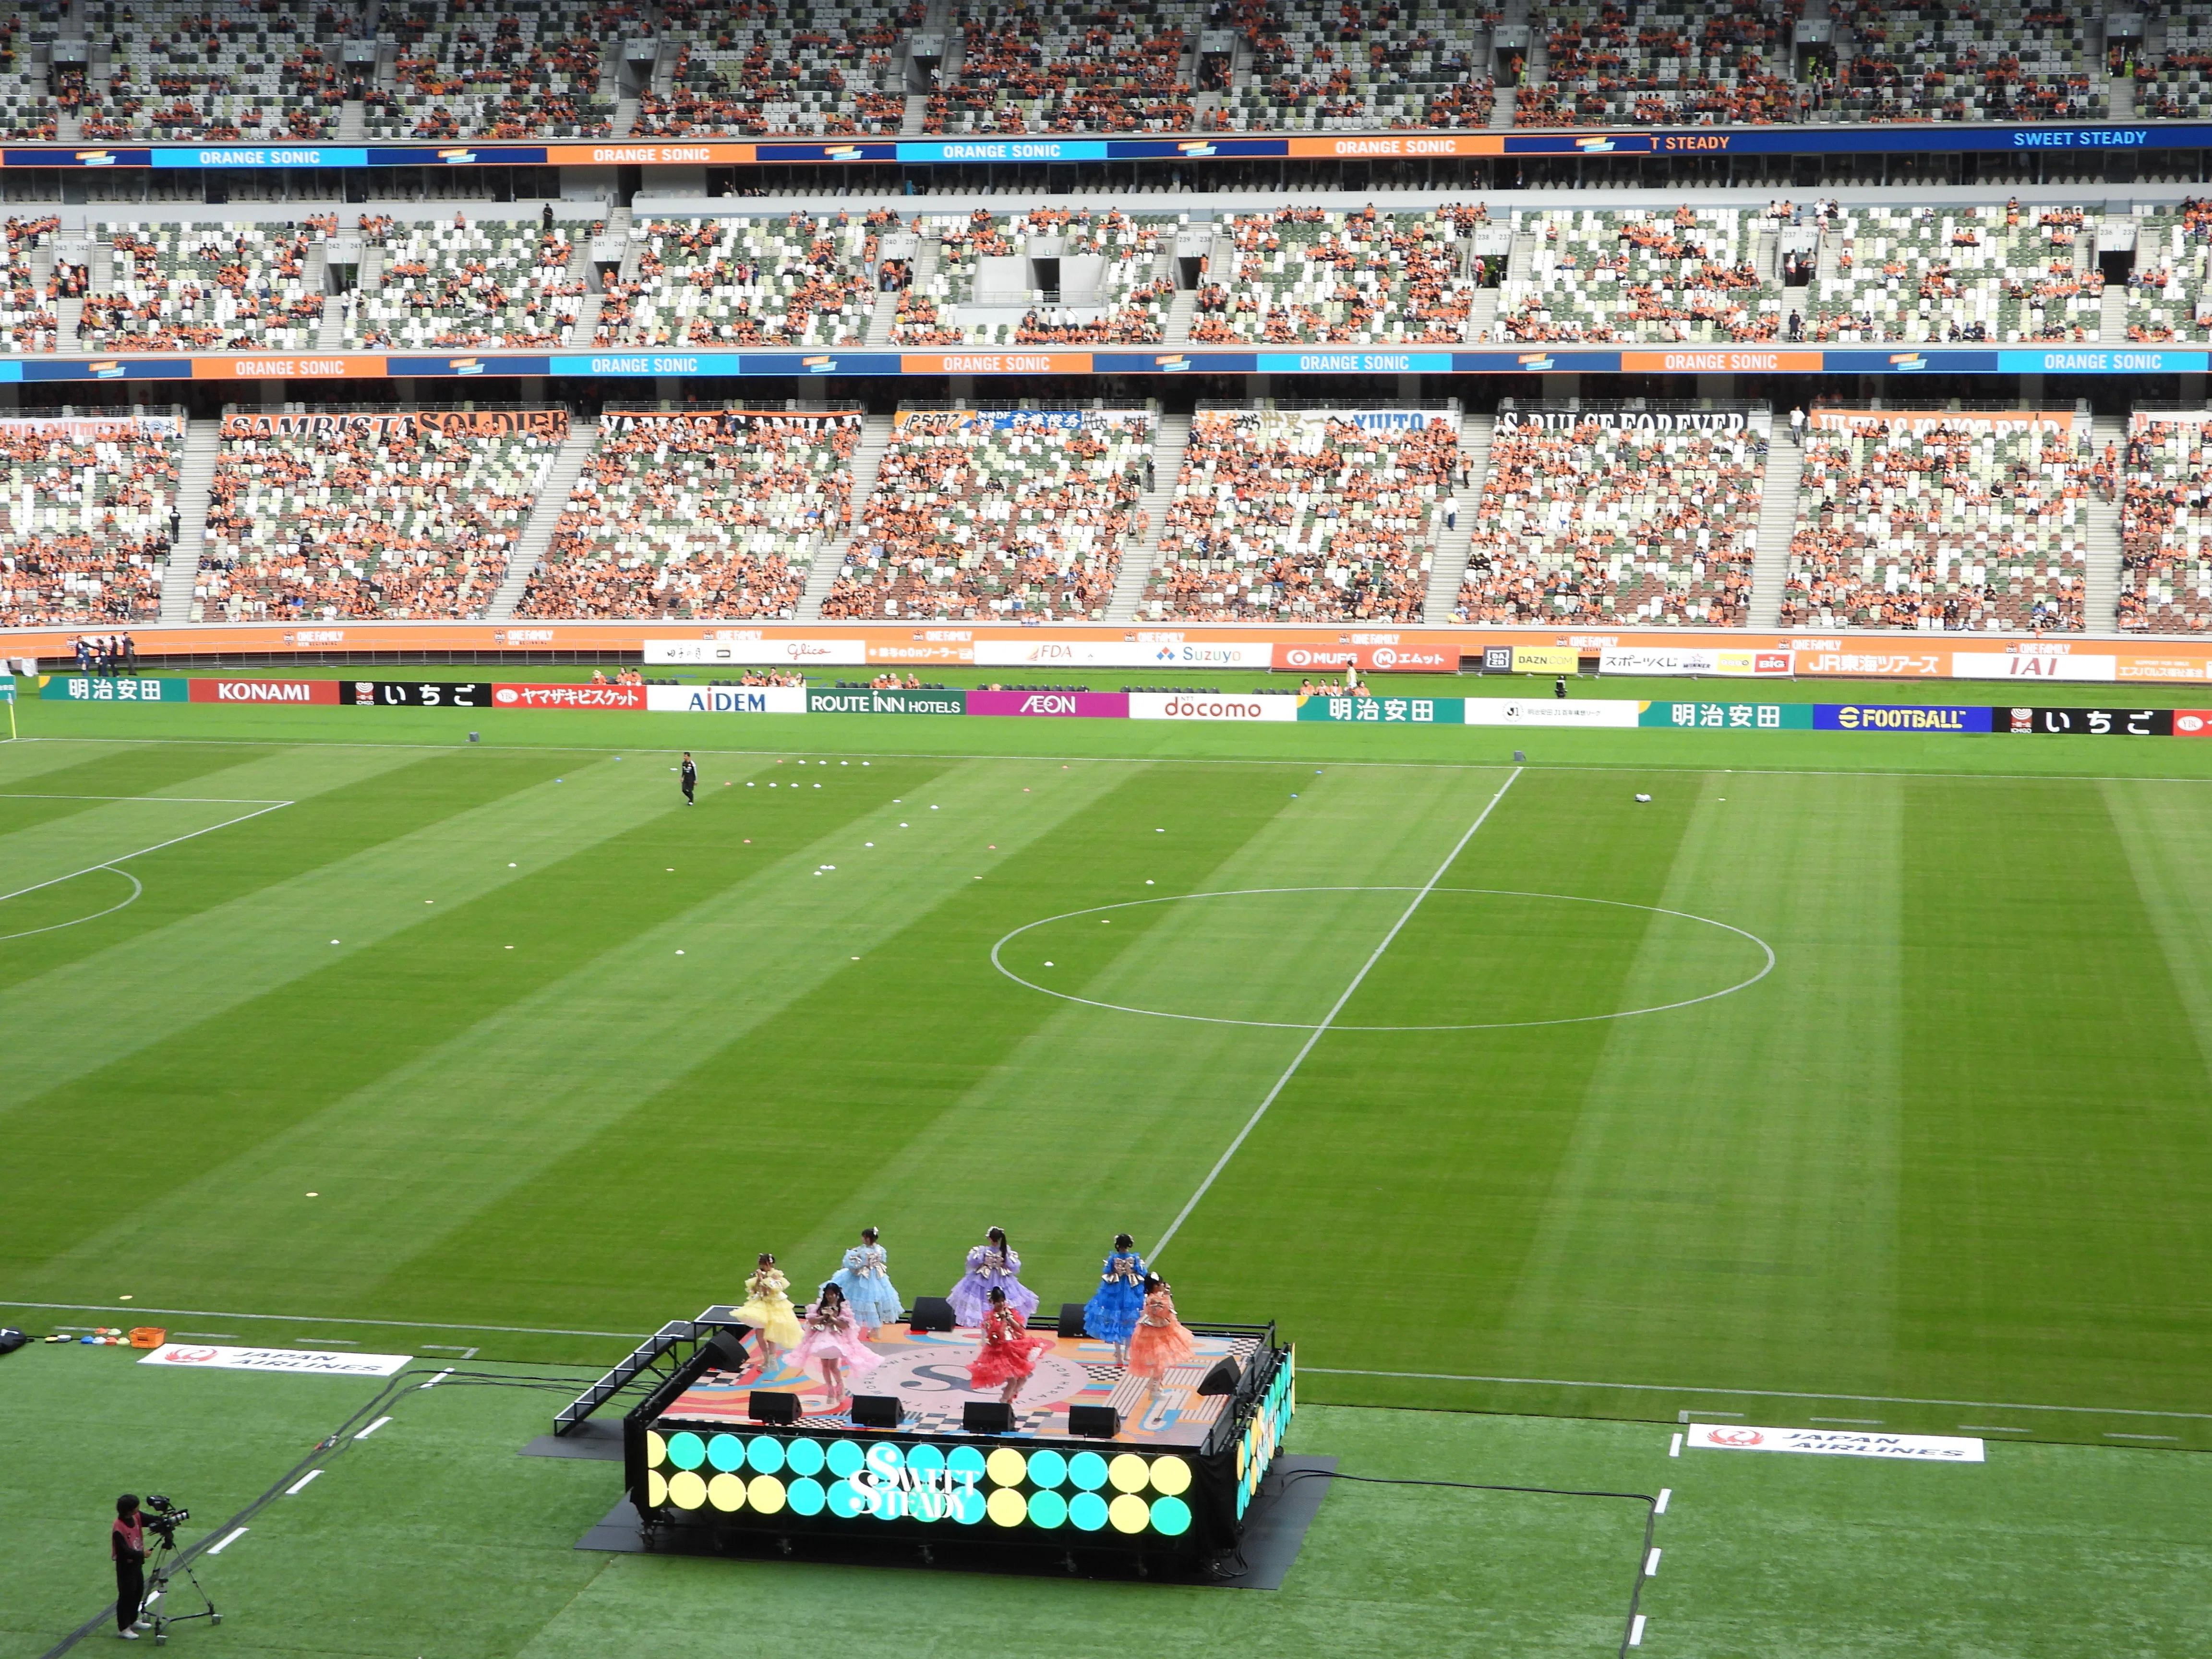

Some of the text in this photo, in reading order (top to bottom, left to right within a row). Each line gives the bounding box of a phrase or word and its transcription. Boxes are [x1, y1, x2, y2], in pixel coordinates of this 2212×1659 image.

[1665, 135, 1730, 149] STEADY
[2013, 131, 2147, 146] SWEET STEADY
[943, 144, 1061, 158] ORANGE SONIC
[1335, 140, 1456, 154] ORANGE SONIC
[200, 151, 320, 164] ORANGE SONIC
[593, 148, 710, 162] ORANGE SONIC
[236, 361, 344, 375] ORANGE SONIC
[592, 358, 697, 373] ORANGE SONIC
[943, 357, 1050, 371] ORANGE SONIC
[1300, 355, 1409, 369] ORANGE SONIC
[1665, 354, 1777, 369] ORANGE SONIC
[2044, 354, 2162, 369] ORANGE SONIC
[1619, 412, 1743, 433] FOREVER
[1996, 419, 2060, 434] DEAD
[297, 631, 344, 641] ONE FAMILY
[508, 630, 553, 640] ONE FAMILY
[716, 630, 763, 640] ONE FAMILY
[926, 631, 972, 641] ONE FAMILY
[1138, 632, 1185, 642] ONE FAMILY
[1352, 634, 1399, 644] ONE FAMILY
[1570, 636, 1618, 647] ONE FAMILY
[787, 643, 832, 661] Glico
[1041, 645, 1072, 658] FDA
[1792, 639, 1841, 651] ONE FAMILY
[2020, 643, 2071, 654] ONE FAMILY
[1183, 646, 1241, 664] Suzuyo
[1313, 652, 1358, 665] MUFG
[1398, 653, 1445, 665] エムット
[1606, 655, 1678, 668] スポーツくじ
[1809, 654, 1939, 674] JR東海ツアーズ
[2010, 657, 2058, 676] IAI
[68, 678, 161, 700] 明治安田
[218, 684, 310, 700] KONAMI
[385, 684, 476, 704] いちご
[521, 688, 639, 706] ヤマザキビスケット
[811, 696, 869, 712] ROUTE
[909, 701, 961, 714] HOTELS
[1165, 696, 1262, 718] docomo
[1329, 698, 1434, 722] 明治安田
[1672, 702, 1780, 728] 明治安田
[2046, 710, 2154, 734] いちご
[233, 1352, 338, 1361] JAPAN
[229, 1359, 383, 1371] AIRLINES
[1782, 1433, 1901, 1444] JAPAN
[1790, 1442, 1965, 1457] AIRLINES
[866, 1446, 981, 1497] SWEET
[849, 1469, 971, 1520] STEADY
